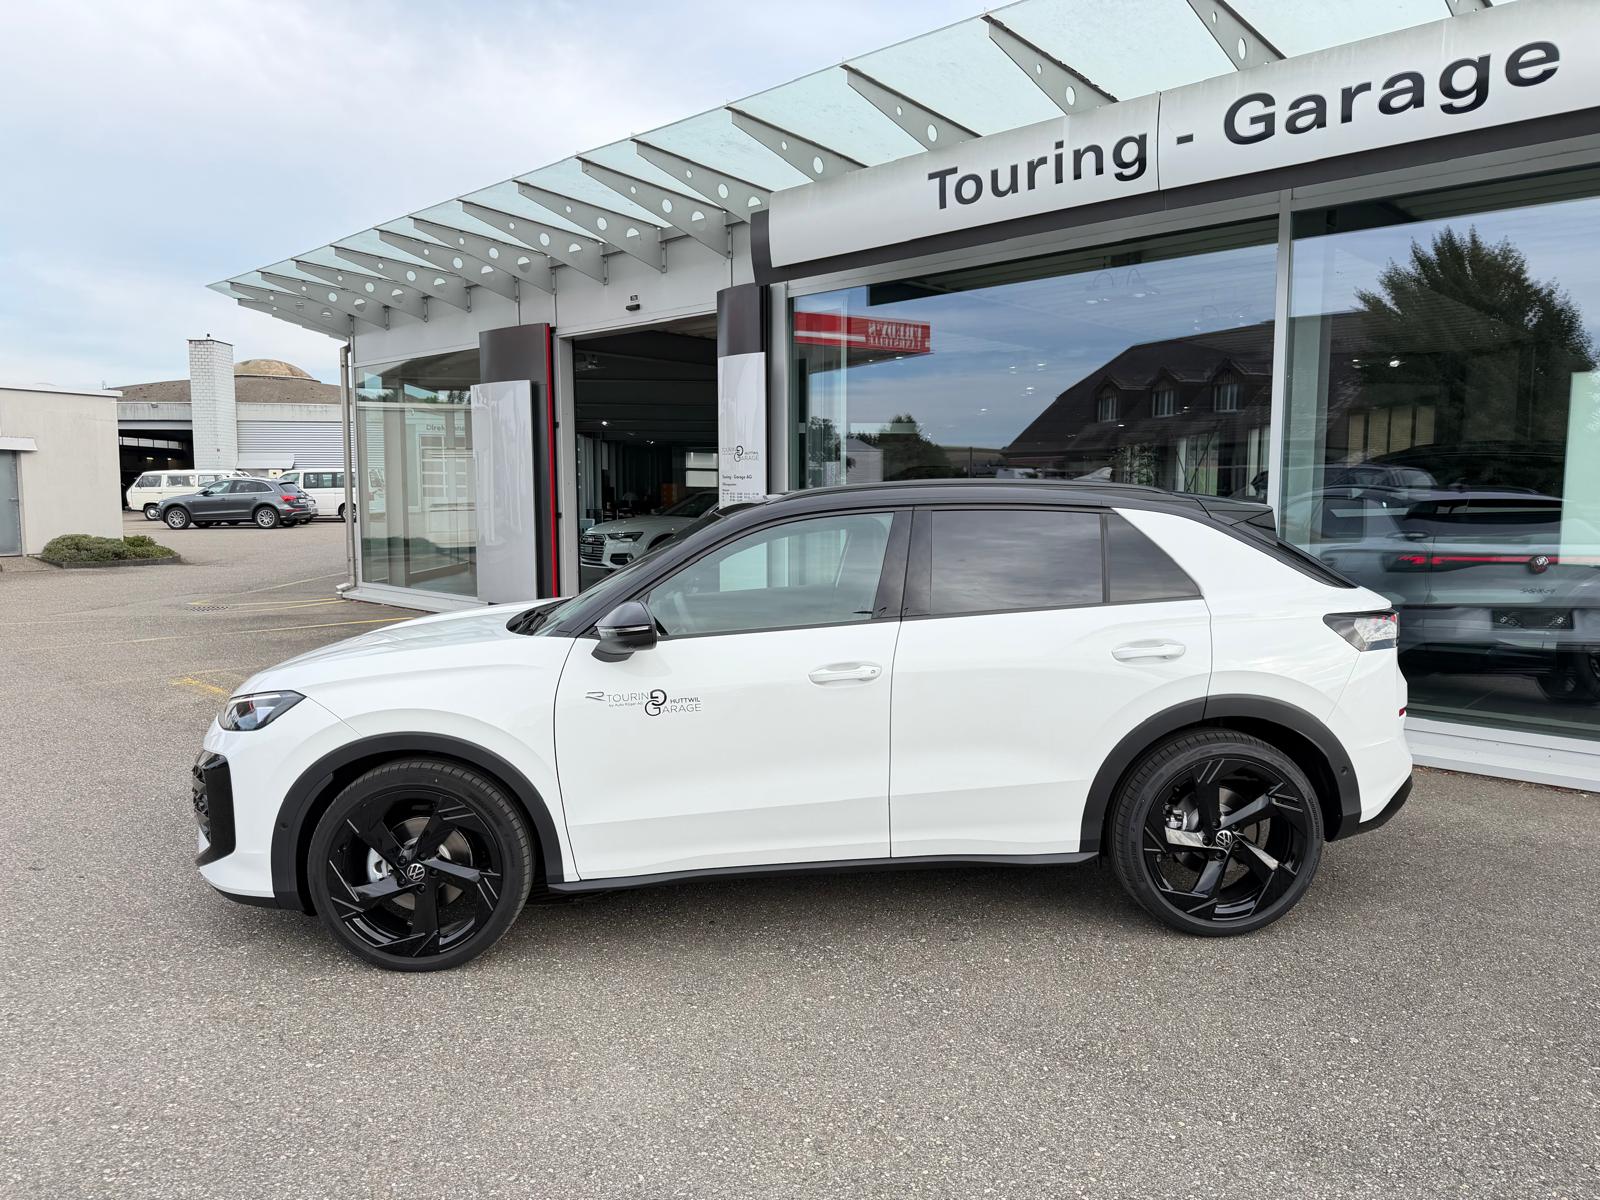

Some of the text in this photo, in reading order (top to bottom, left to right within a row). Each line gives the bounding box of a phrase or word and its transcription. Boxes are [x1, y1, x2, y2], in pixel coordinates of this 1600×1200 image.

[928, 133, 1148, 210] Touring
[1223, 40, 1561, 146] Garage
[644, 699, 702, 716] GARAGE
